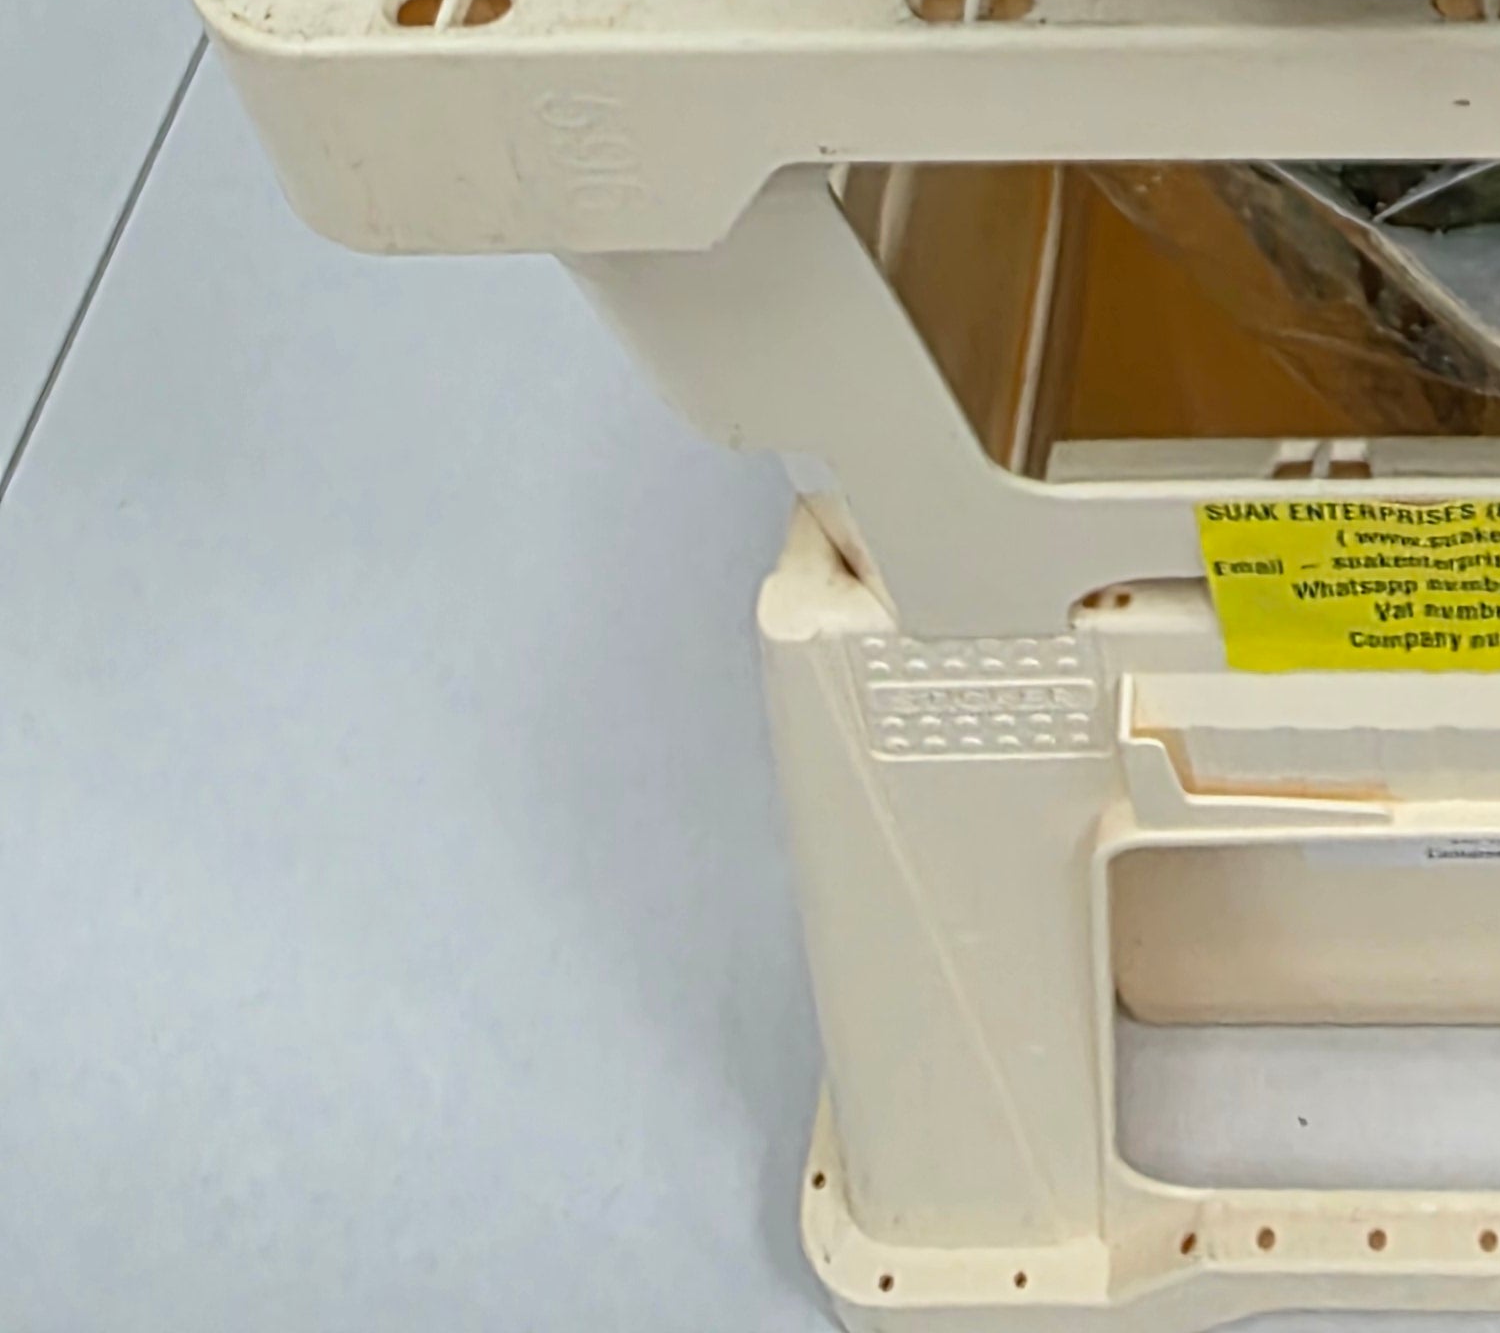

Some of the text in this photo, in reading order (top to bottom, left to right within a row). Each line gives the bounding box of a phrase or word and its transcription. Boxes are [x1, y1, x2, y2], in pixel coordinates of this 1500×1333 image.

[1206, 502, 1279, 523] SUAK
[1289, 502, 1476, 524] ENTERPRISES
[1214, 556, 1284, 577] Email
[1293, 576, 1418, 602] Whatsapp
[1374, 602, 1415, 625] Vat
[1350, 629, 1462, 653] Company
